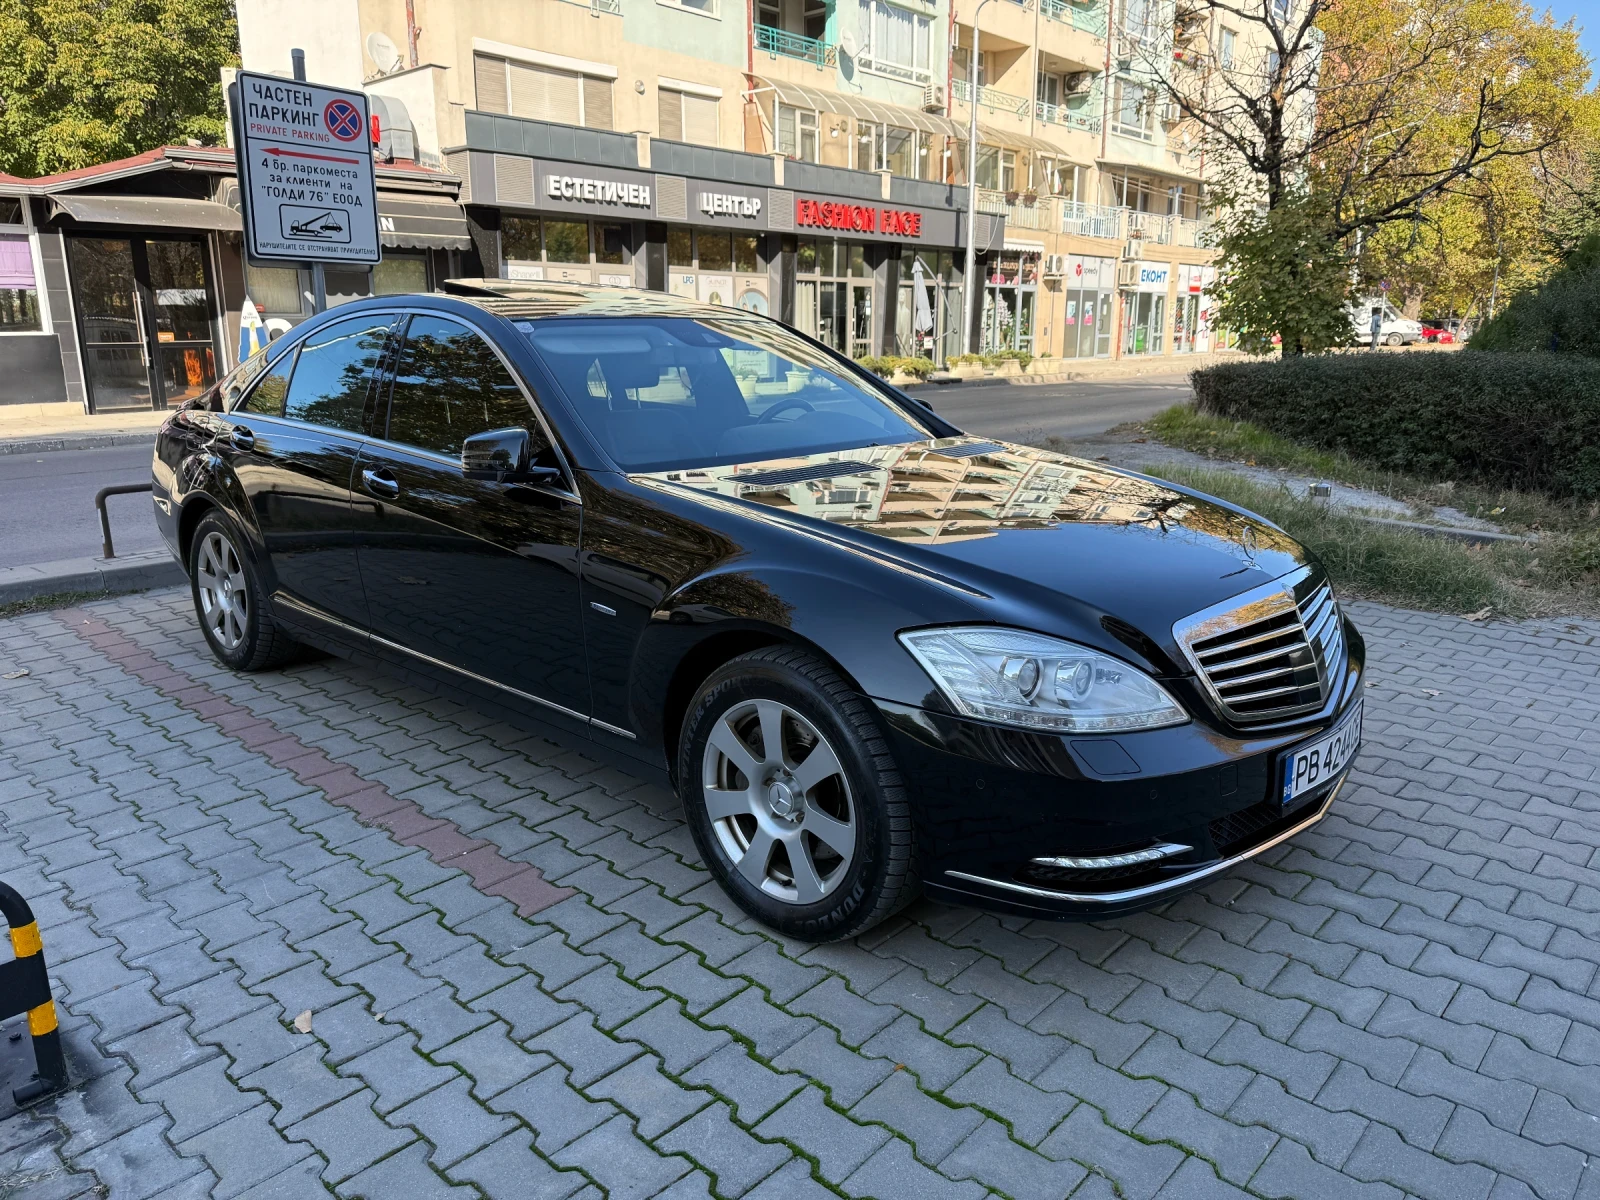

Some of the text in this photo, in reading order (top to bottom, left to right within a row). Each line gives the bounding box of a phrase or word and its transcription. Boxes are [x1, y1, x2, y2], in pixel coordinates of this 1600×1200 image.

[252, 82, 313, 107] ЧАСТЕН
[249, 102, 320, 128] ПАРКИНГ
[250, 122, 330, 143] PRIVATE PARKING
[261, 157, 359, 179] 4 бр. паркоместа
[269, 174, 353, 191] за клиенти на
[261, 185, 363, 208] "ГОЛДИ 76" ЕООД
[546, 174, 762, 217] ЕСТЕТИЧЕН ЦЕНТЪР
[797, 198, 922, 236] FASHION FACE
[682, 275, 694, 285] LPG
[1083, 266, 1099, 277] speedy
[1140, 269, 1168, 283] ЕКОНТ
[680, 704, 705, 779] WINTER
[1295, 749, 1320, 791] PB
